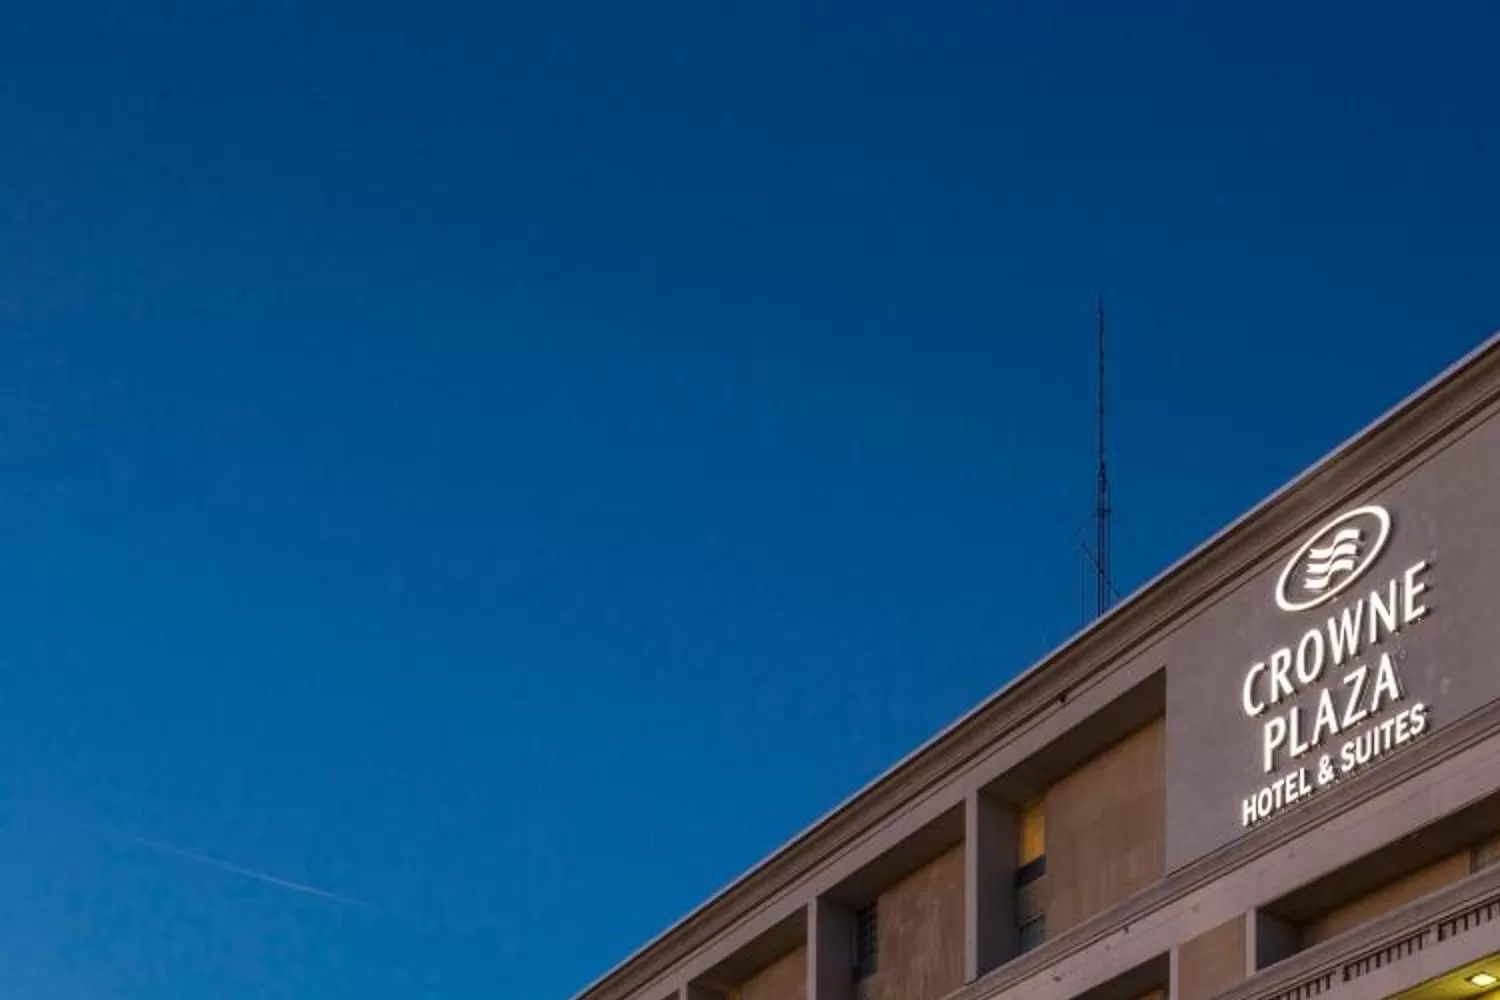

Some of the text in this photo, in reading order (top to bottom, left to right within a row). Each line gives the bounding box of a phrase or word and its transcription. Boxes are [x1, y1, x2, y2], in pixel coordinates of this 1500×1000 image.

[1243, 561, 1427, 717] CROWNE
[1242, 703, 1426, 826] HOTEL & SUITES
[1263, 653, 1400, 773] PLAZA
